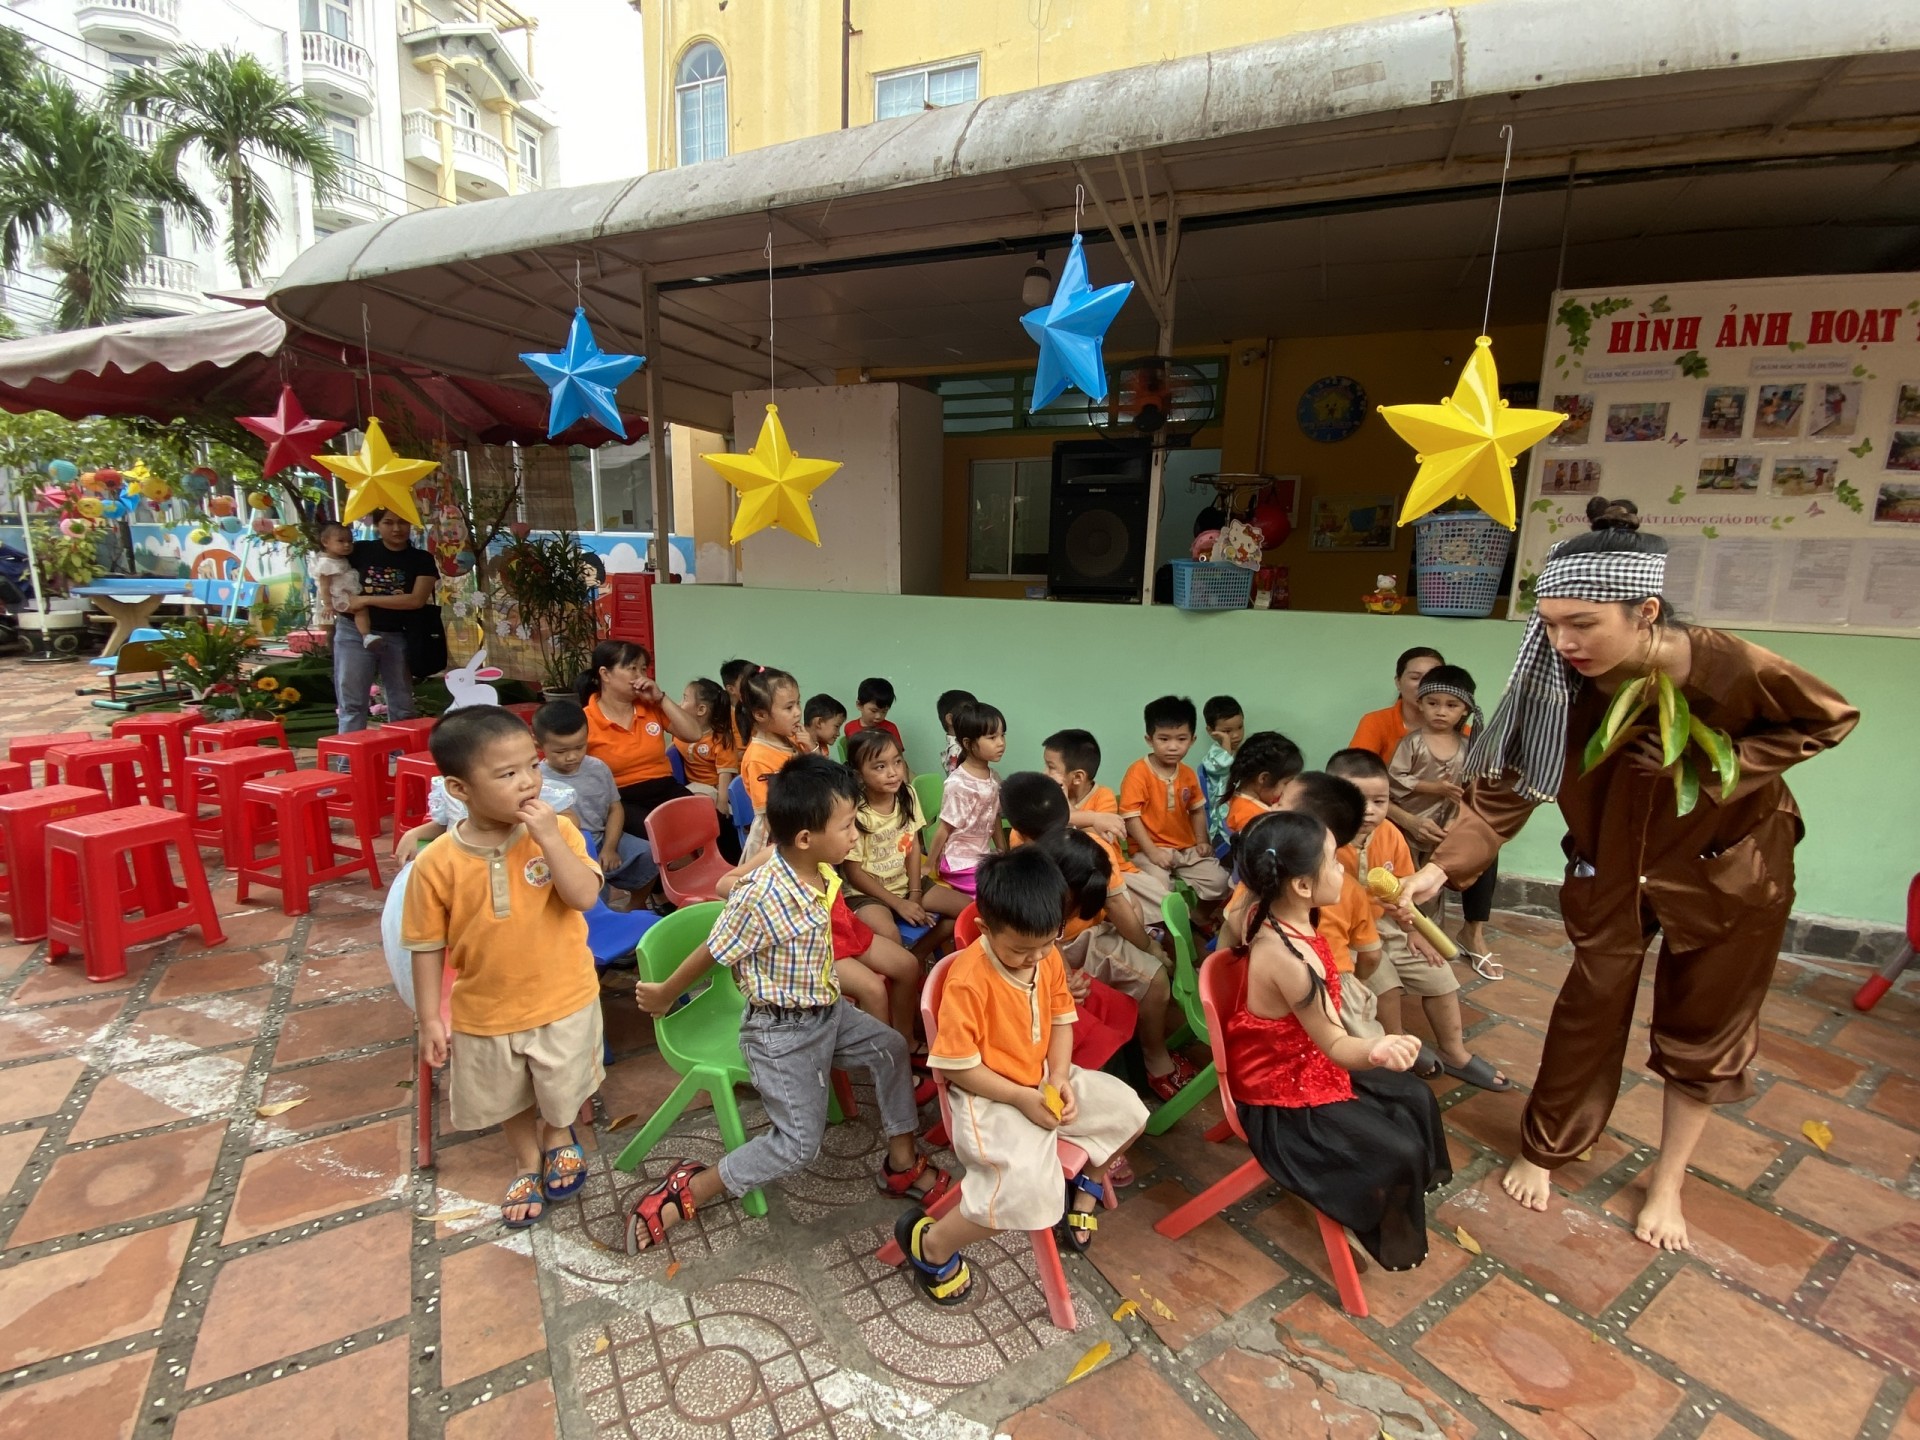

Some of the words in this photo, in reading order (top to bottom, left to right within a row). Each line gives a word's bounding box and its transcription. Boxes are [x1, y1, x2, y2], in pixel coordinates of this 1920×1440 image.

[1607, 312, 1702, 353] HÌNH
[1715, 303, 1793, 346] ẢNH
[1806, 308, 1903, 351] HOẠT
[1709, 513, 1742, 524] GIÁO
[1744, 515, 1772, 526] DỤC
